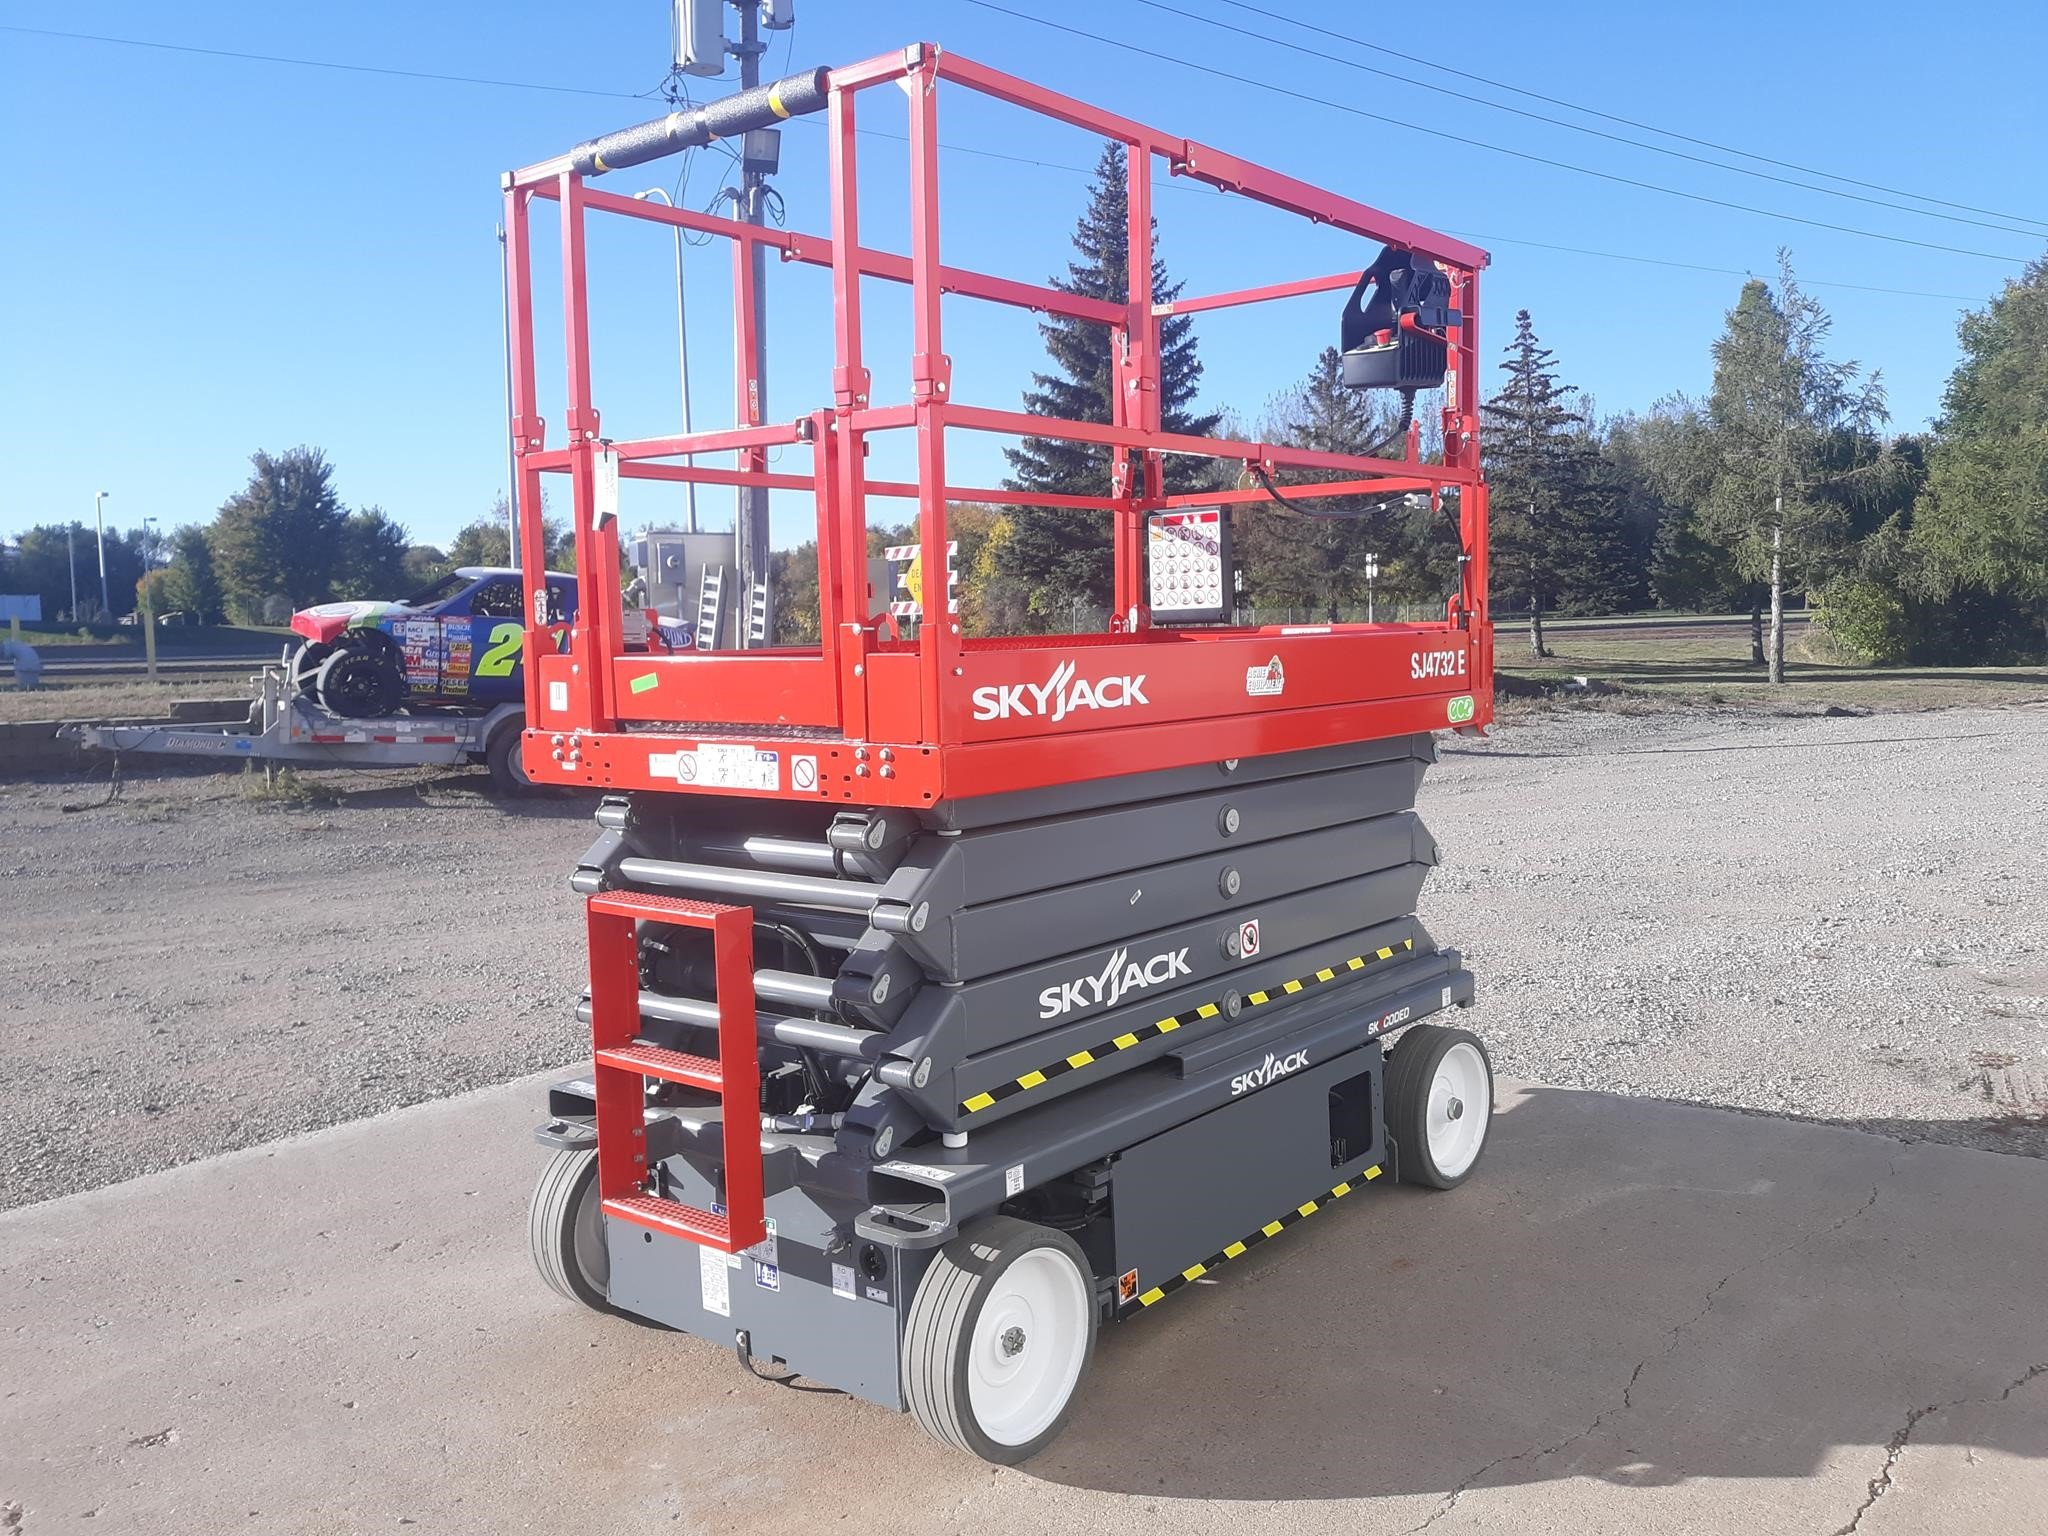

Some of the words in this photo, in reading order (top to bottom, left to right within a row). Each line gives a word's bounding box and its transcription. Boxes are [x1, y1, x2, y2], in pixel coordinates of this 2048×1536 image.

[911, 569, 921, 578] DE
[913, 584, 921, 593] EN
[1410, 650, 1455, 679] SJ4732
[1457, 649, 1466, 675] E
[972, 659, 1150, 722] SKYJACK
[1038, 946, 1193, 1019] SKYJACK
[1231, 1048, 1310, 1096] SKYJACK
